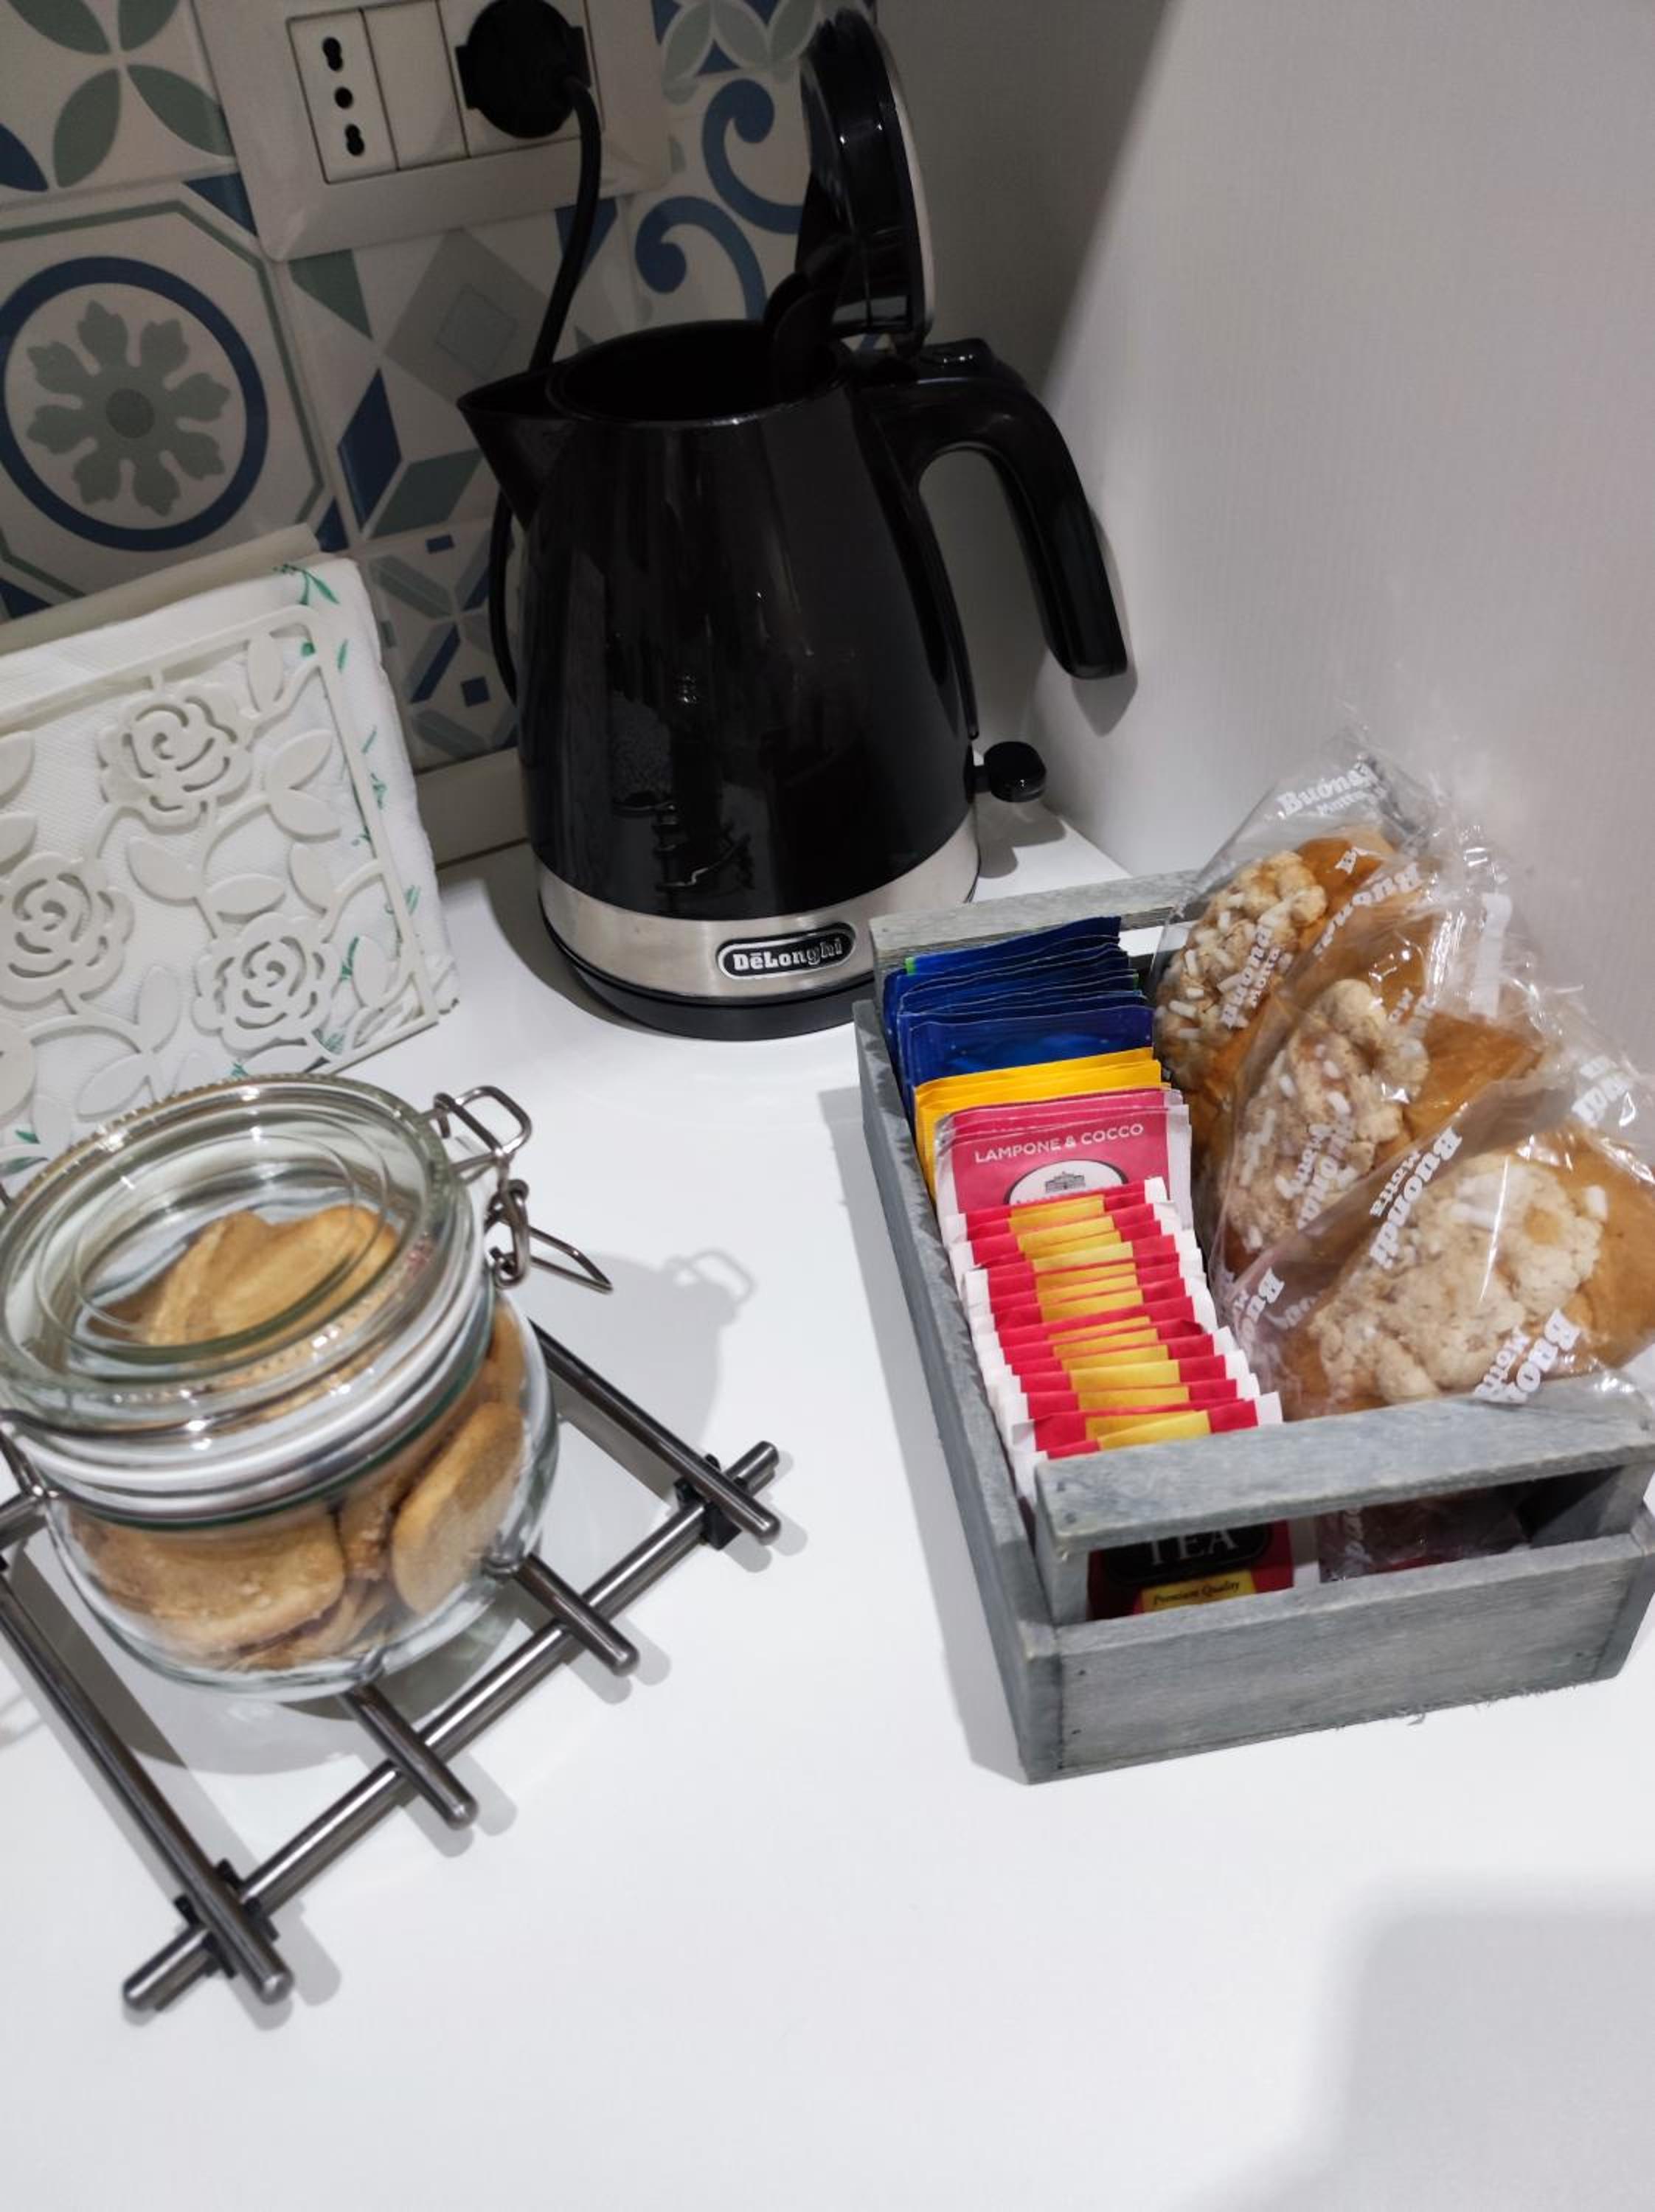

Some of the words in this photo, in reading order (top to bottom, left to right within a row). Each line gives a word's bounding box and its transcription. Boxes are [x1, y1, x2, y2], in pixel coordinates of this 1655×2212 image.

[974, 1138, 1061, 1163] LAMPONE
[1064, 1135, 1077, 1149] &
[1080, 1123, 1144, 1145] COCCO
